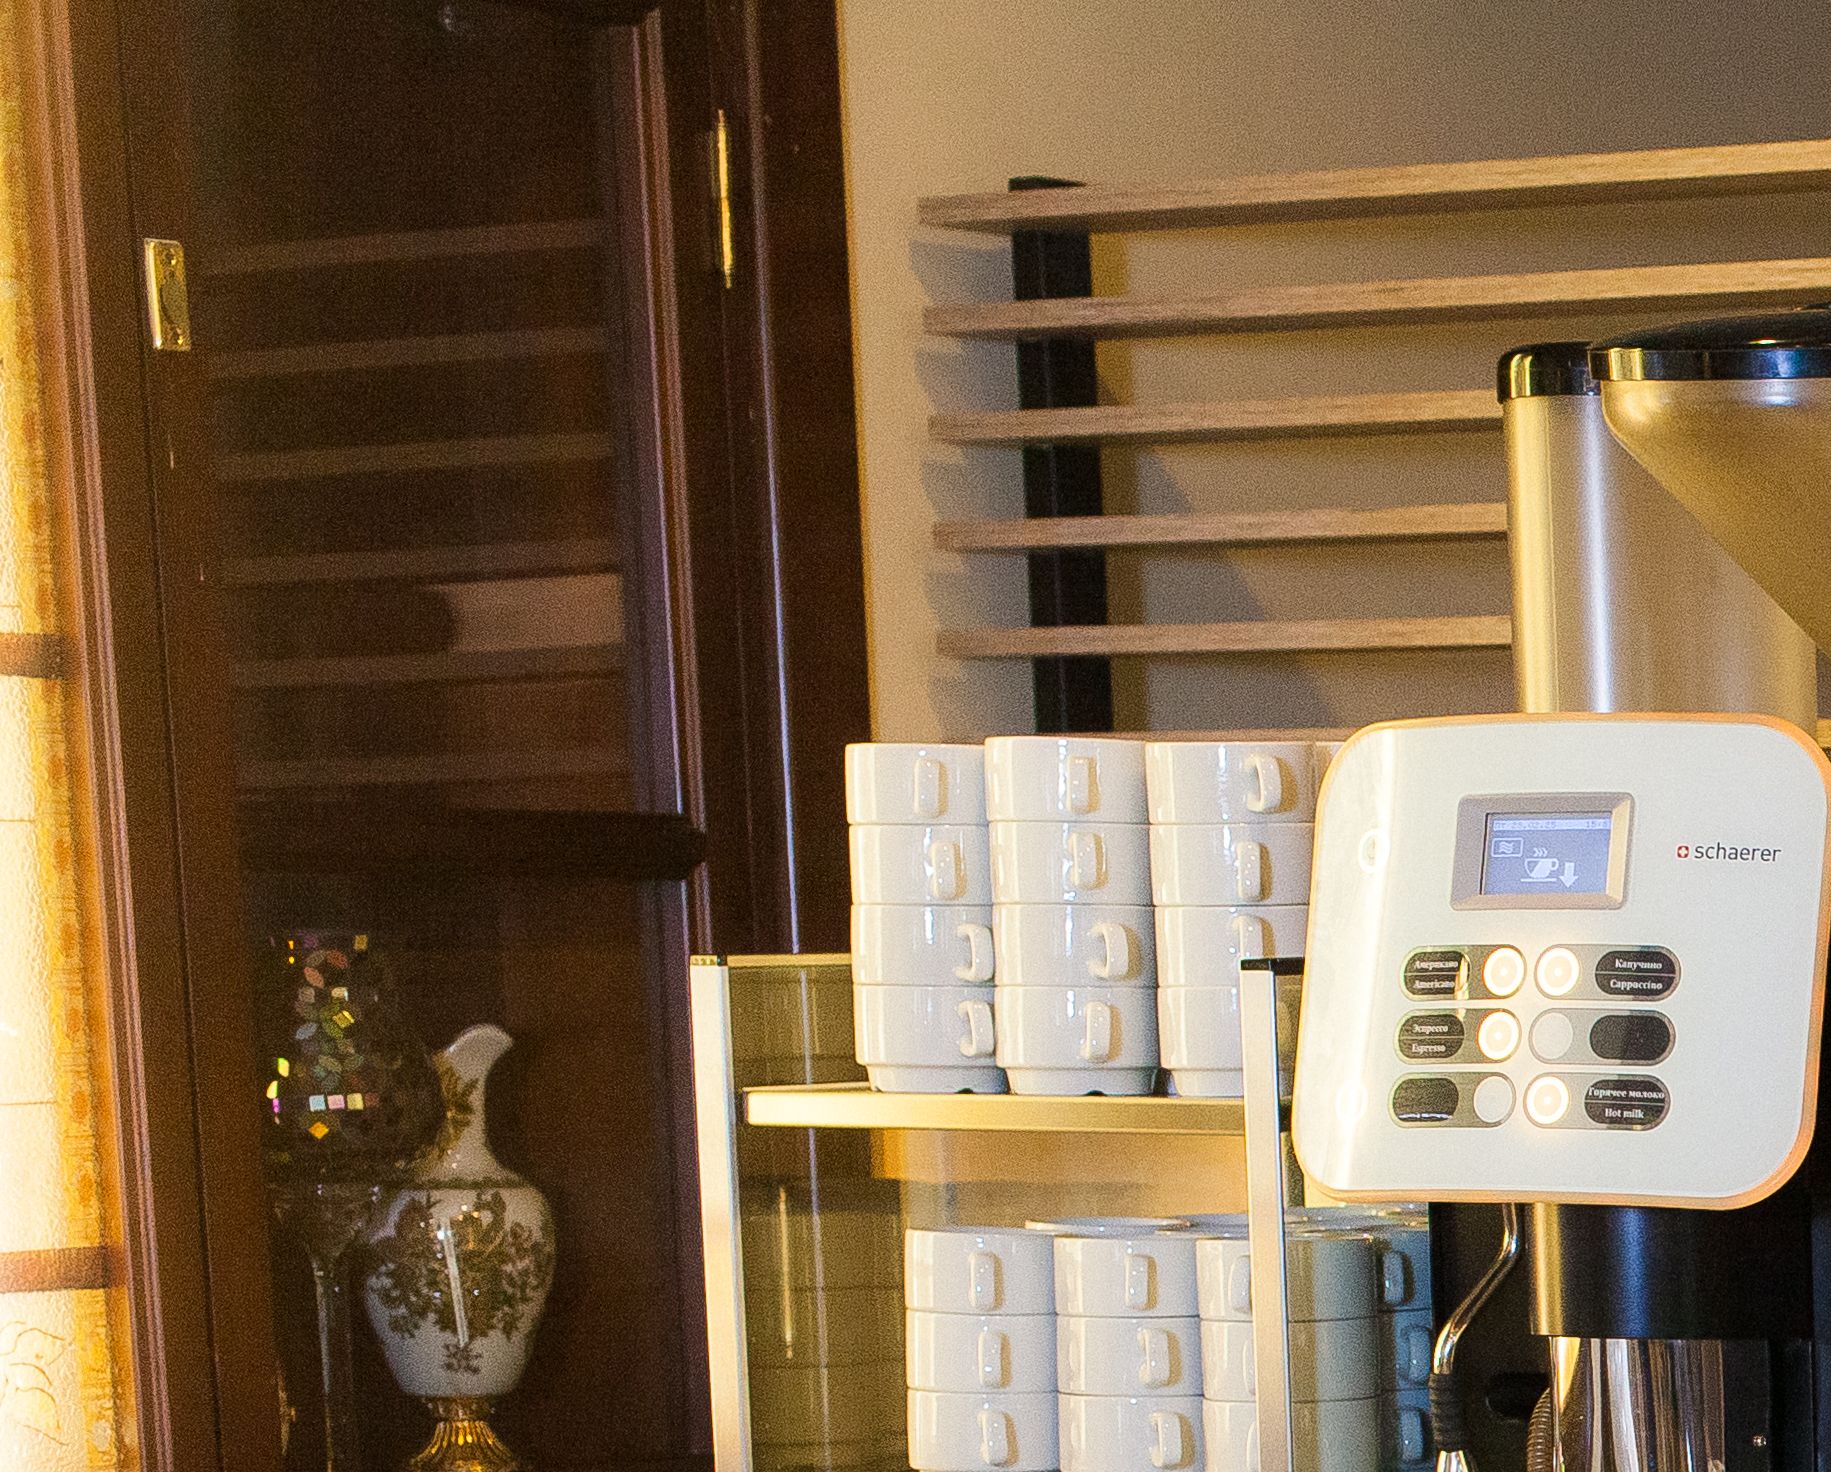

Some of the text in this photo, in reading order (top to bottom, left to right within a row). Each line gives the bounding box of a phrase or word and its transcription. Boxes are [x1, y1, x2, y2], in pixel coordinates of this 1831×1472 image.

[1694, 842, 1782, 862] schaerer
[1615, 958, 1663, 970] Капучино
[1605, 1108, 1645, 1119] Hot milk
